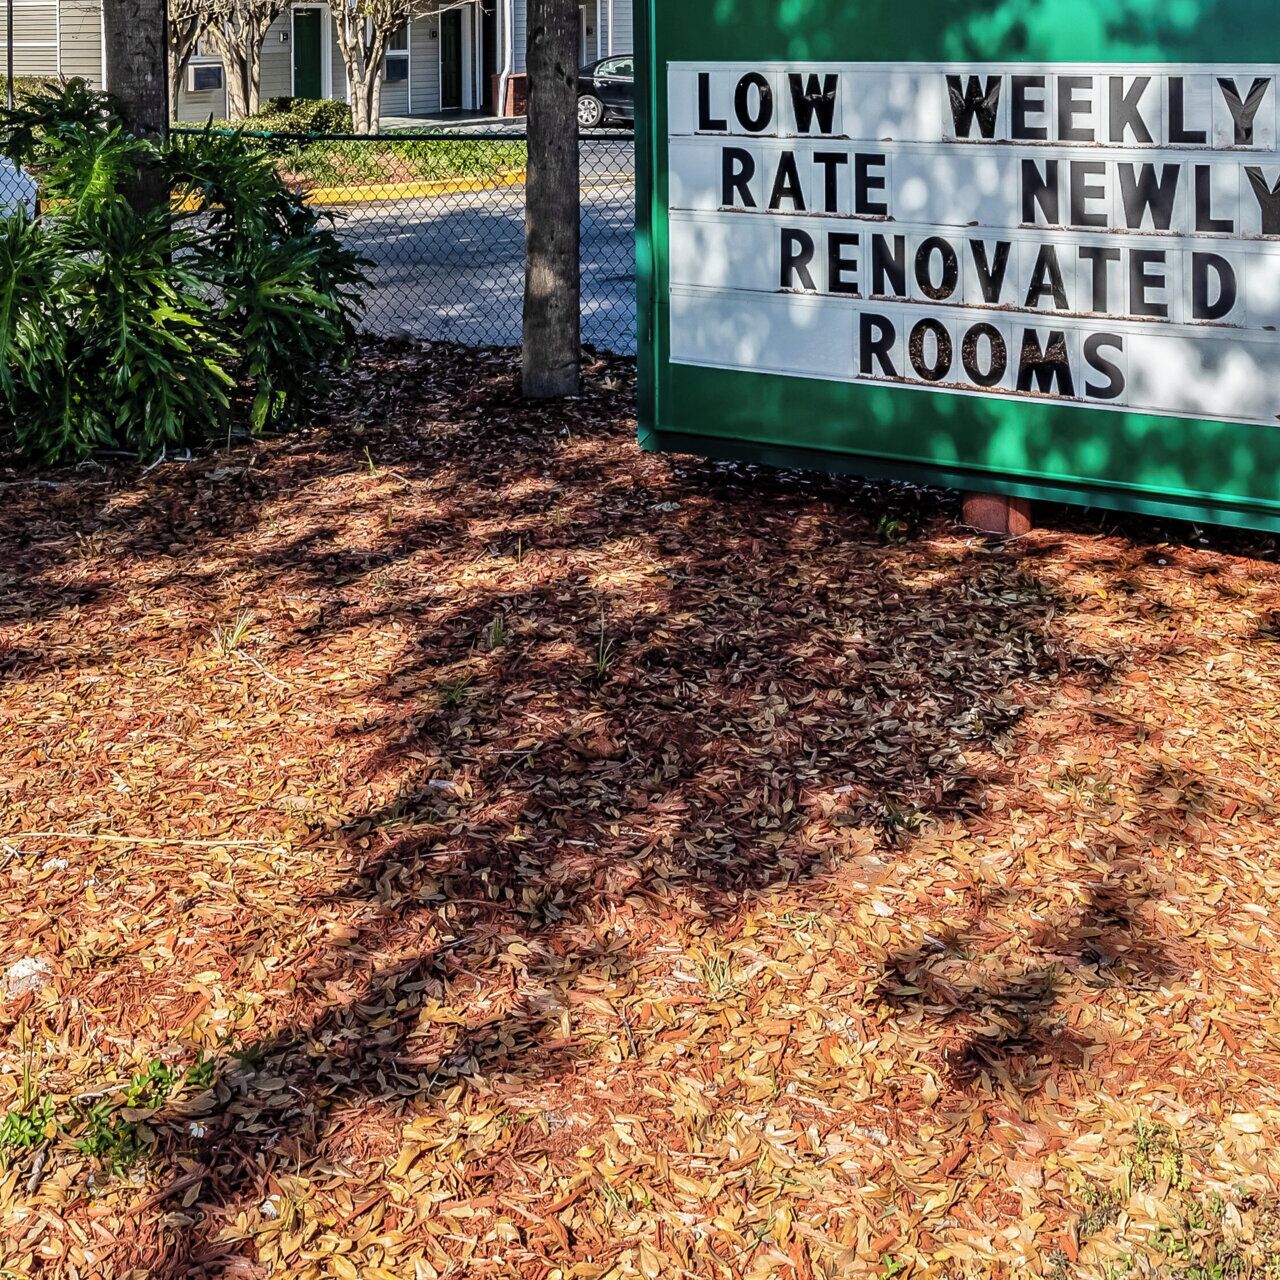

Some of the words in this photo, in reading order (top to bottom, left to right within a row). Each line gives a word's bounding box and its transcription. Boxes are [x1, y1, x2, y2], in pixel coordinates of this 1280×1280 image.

[697, 71, 840, 135] LOW
[946, 74, 1271, 145] WEEKLY
[720, 147, 889, 216] RATE
[779, 228, 1237, 320] RENOVATED
[859, 313, 1124, 401] ROOMS
